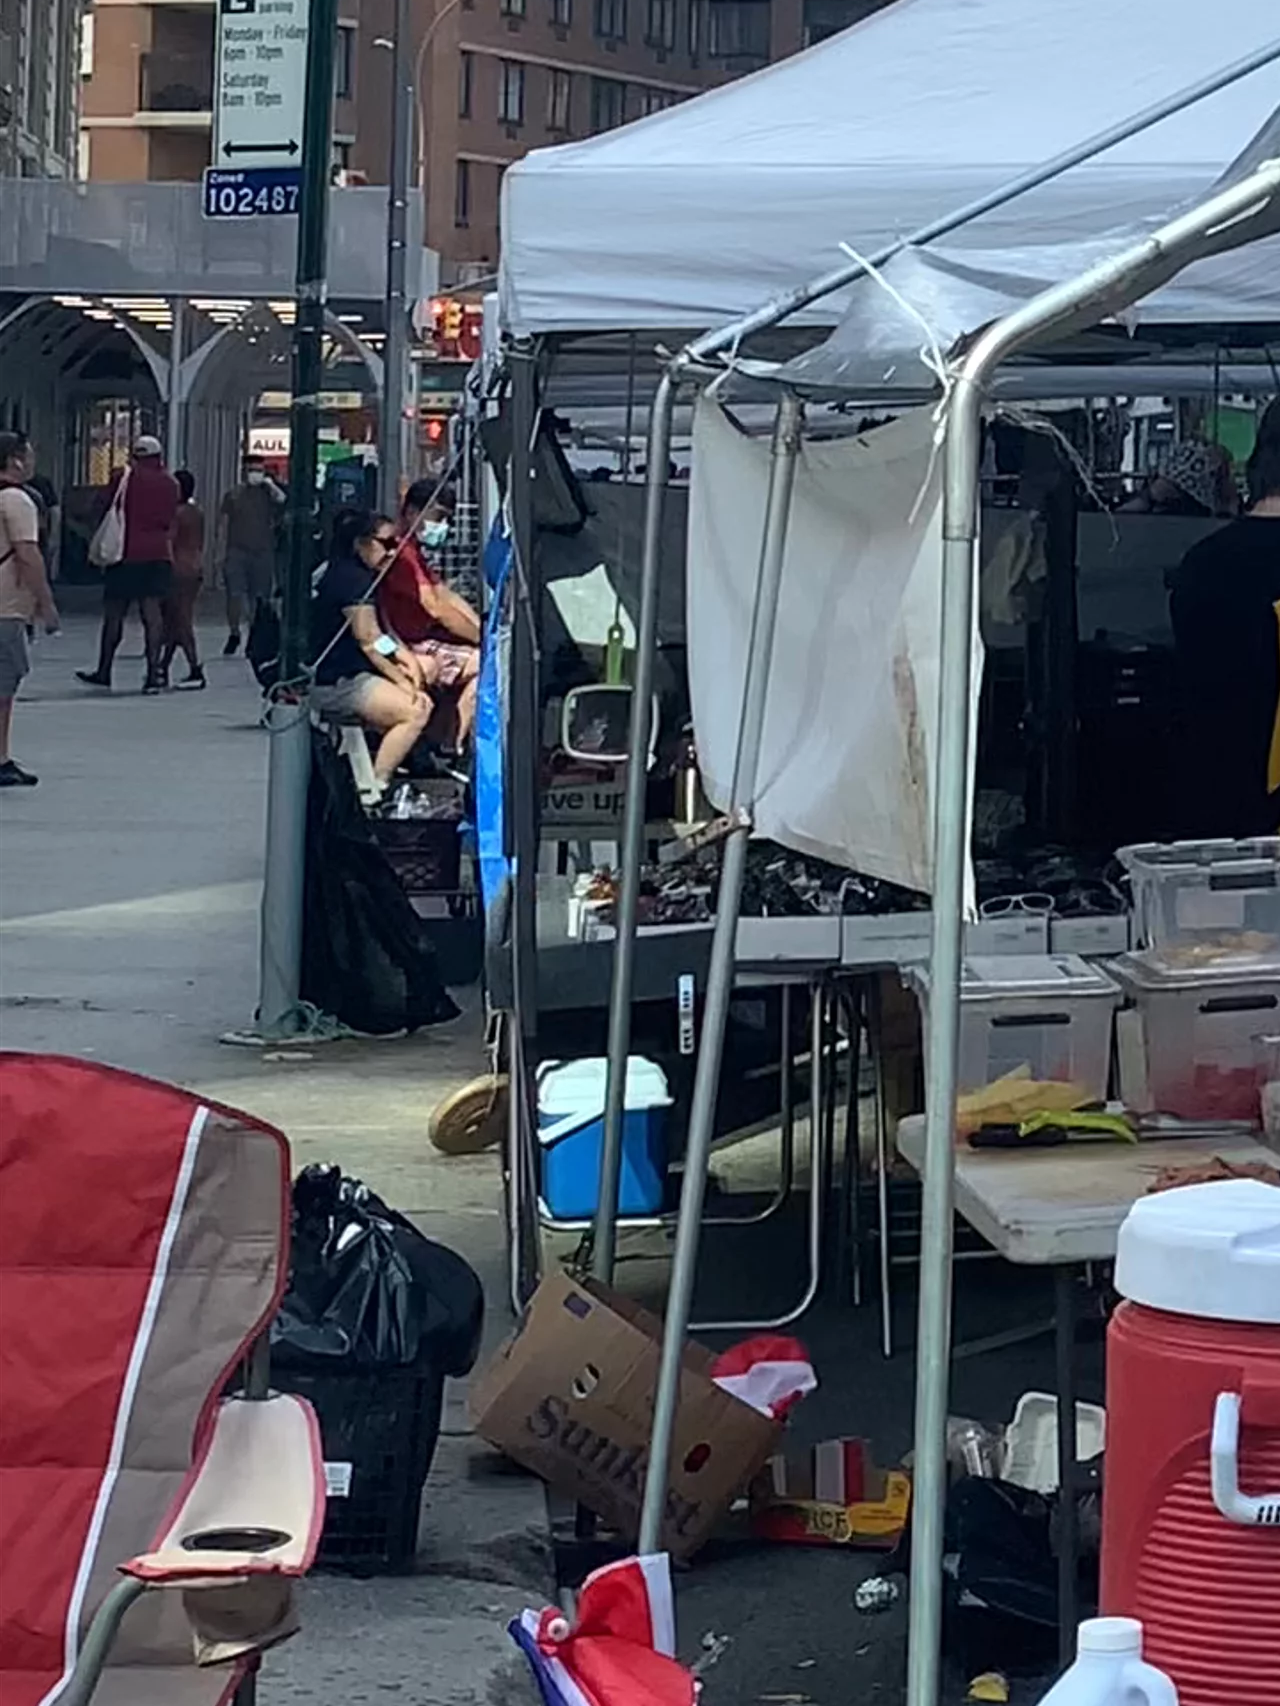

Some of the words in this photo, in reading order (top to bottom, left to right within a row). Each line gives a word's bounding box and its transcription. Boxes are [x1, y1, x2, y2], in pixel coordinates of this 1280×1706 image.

[259, 1, 294, 14] parking
[223, 27, 264, 42] Monday
[274, 25, 308, 42] Friday
[222, 72, 270, 89] Saturday
[208, 186, 299, 213] 102487
[527, 1395, 698, 1534] Sunkst
